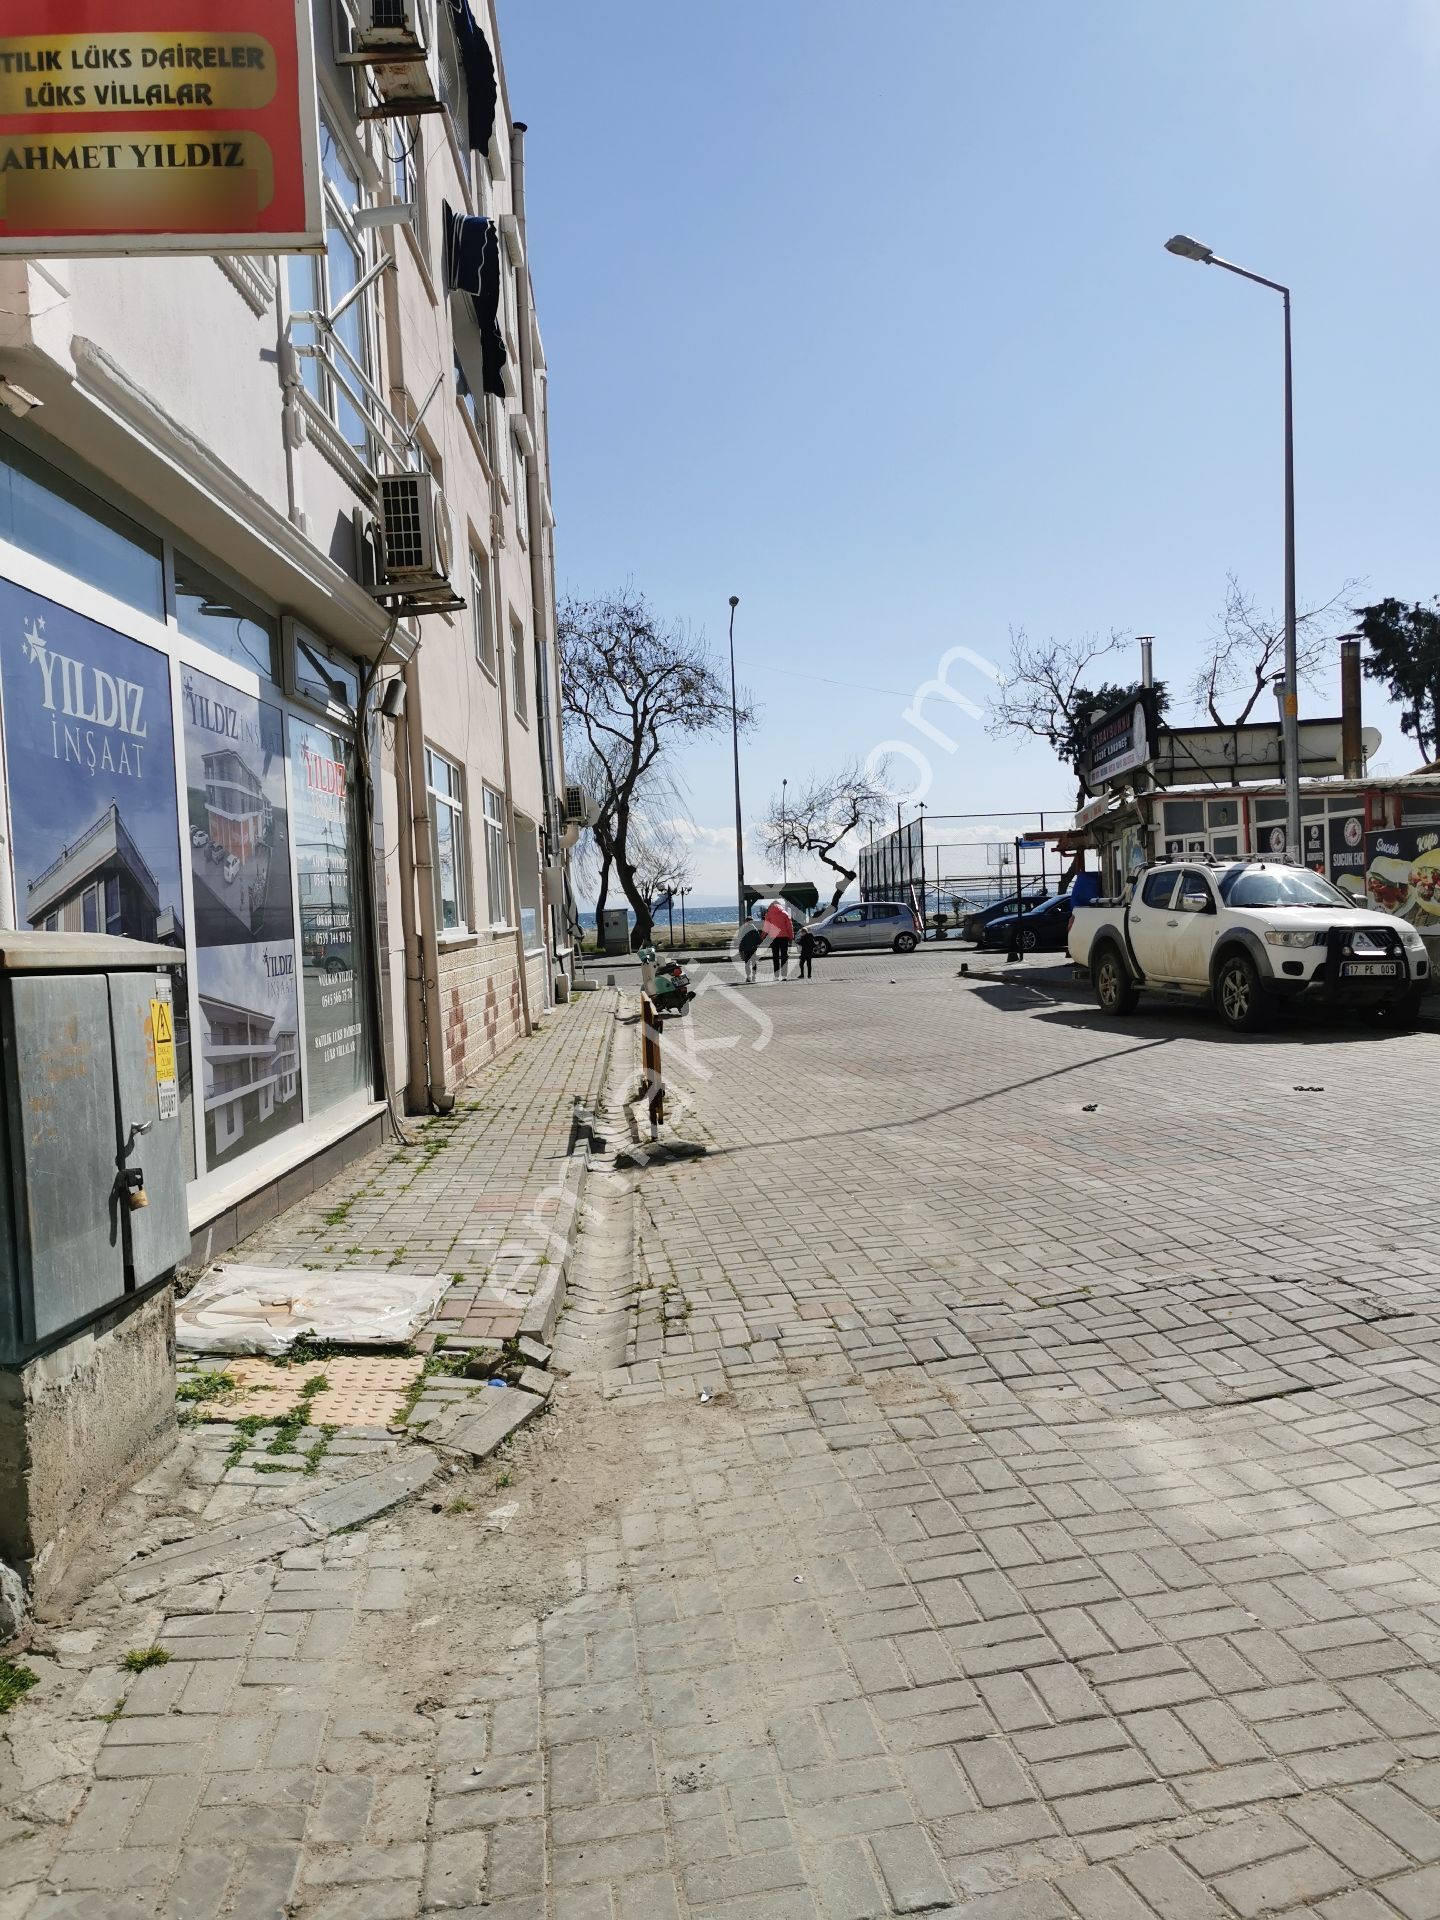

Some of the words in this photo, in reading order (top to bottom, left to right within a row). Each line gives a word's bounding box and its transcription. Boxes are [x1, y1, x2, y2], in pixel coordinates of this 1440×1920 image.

[72, 45, 133, 69] LÜKS
[141, 43, 266, 71] DAİRELER
[25, 82, 87, 108] LÜKS
[94, 80, 213, 107] VİLLALAR
[1, 144, 122, 173] AHMET
[129, 142, 245, 169] YILDIZ
[35, 645, 148, 739] YILDIZ
[188, 691, 239, 740] YILDIZ
[51, 715, 145, 779] İNŞAAT
[304, 750, 347, 799] YILDIZ
[264, 953, 294, 978] YILDIZ
[1350, 965, 1359, 974] 17
[1364, 965, 1375, 974] PE
[1380, 963, 1395, 974] 009
